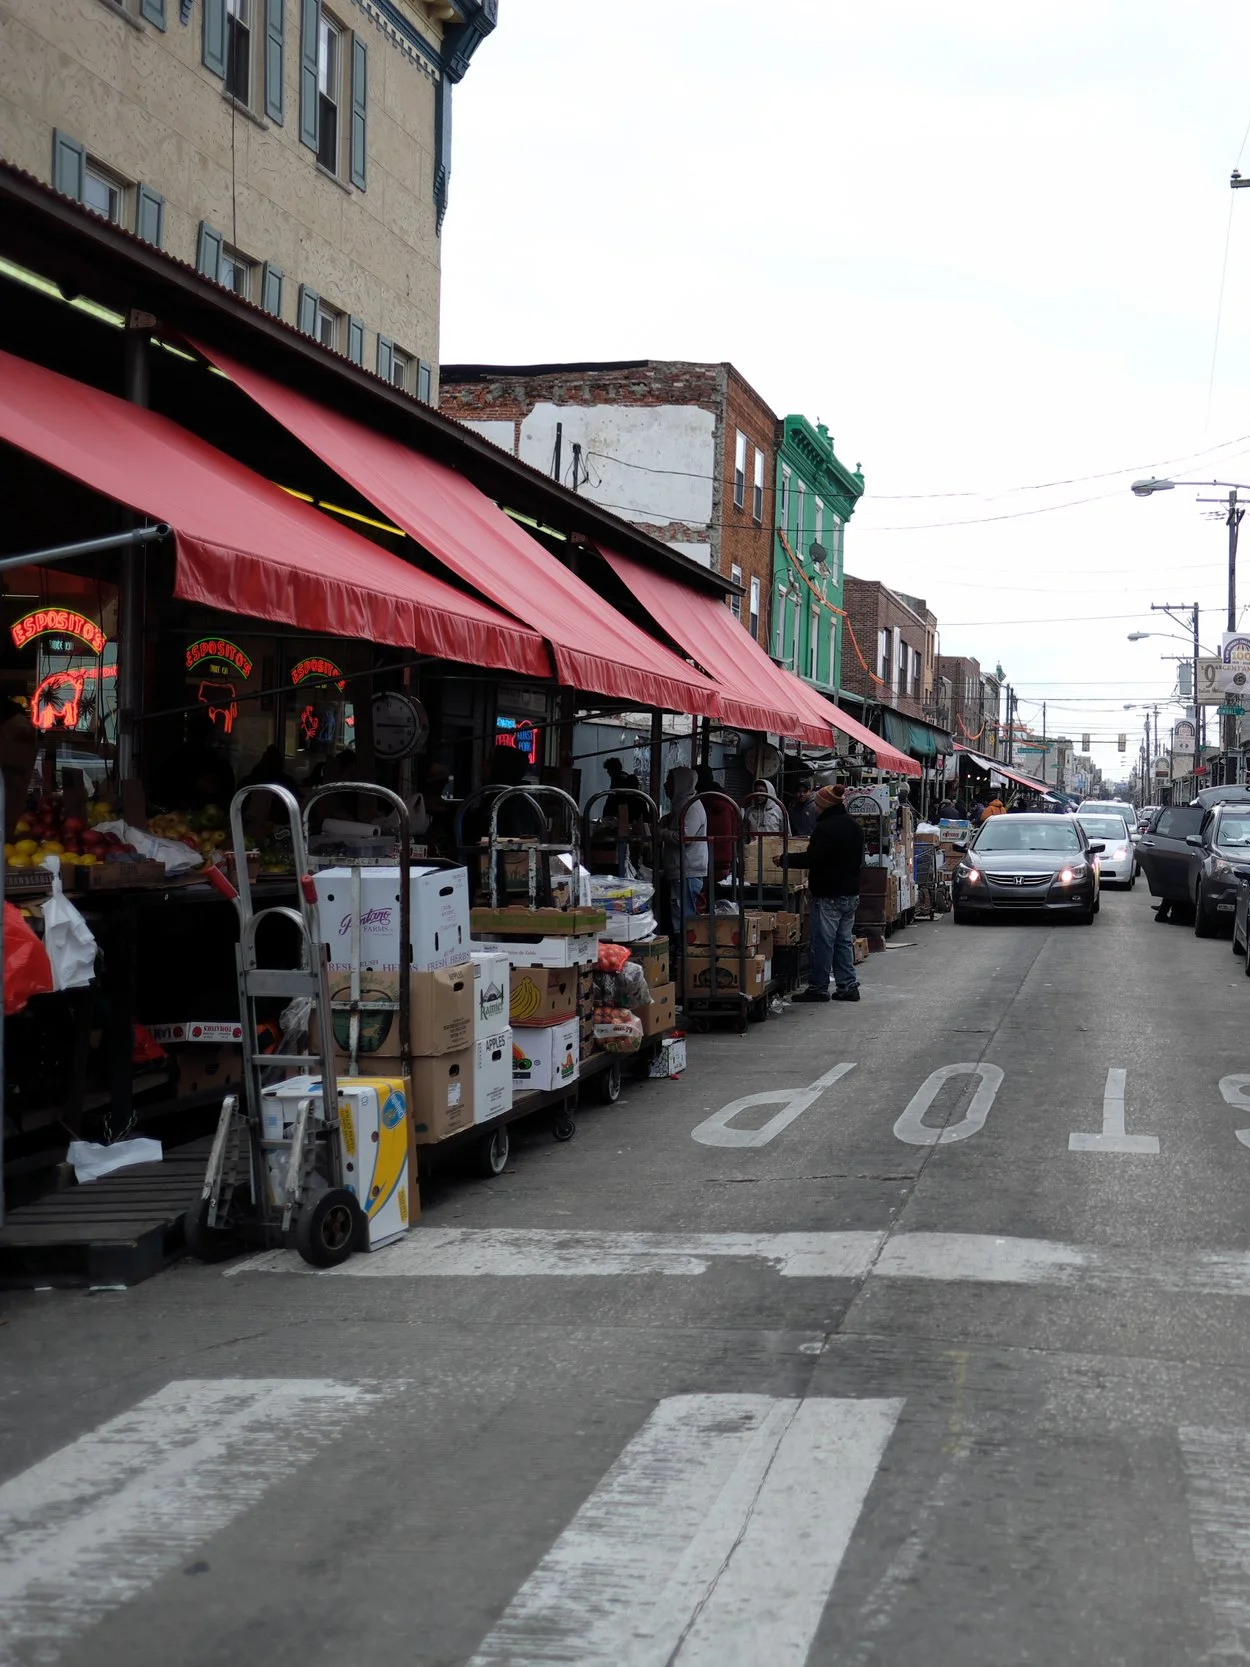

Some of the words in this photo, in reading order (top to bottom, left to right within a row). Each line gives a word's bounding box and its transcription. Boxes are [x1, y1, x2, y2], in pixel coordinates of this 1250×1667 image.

[12, 610, 105, 647] ESPOSITO'S
[186, 641, 252, 677] ESPOSITO'S
[1232, 652, 1250, 661] 100
[339, 908, 392, 935] Pntano
[427, 959, 449, 972] FRESH
[450, 952, 470, 964] HERBS
[485, 1035, 506, 1052] APPLES
